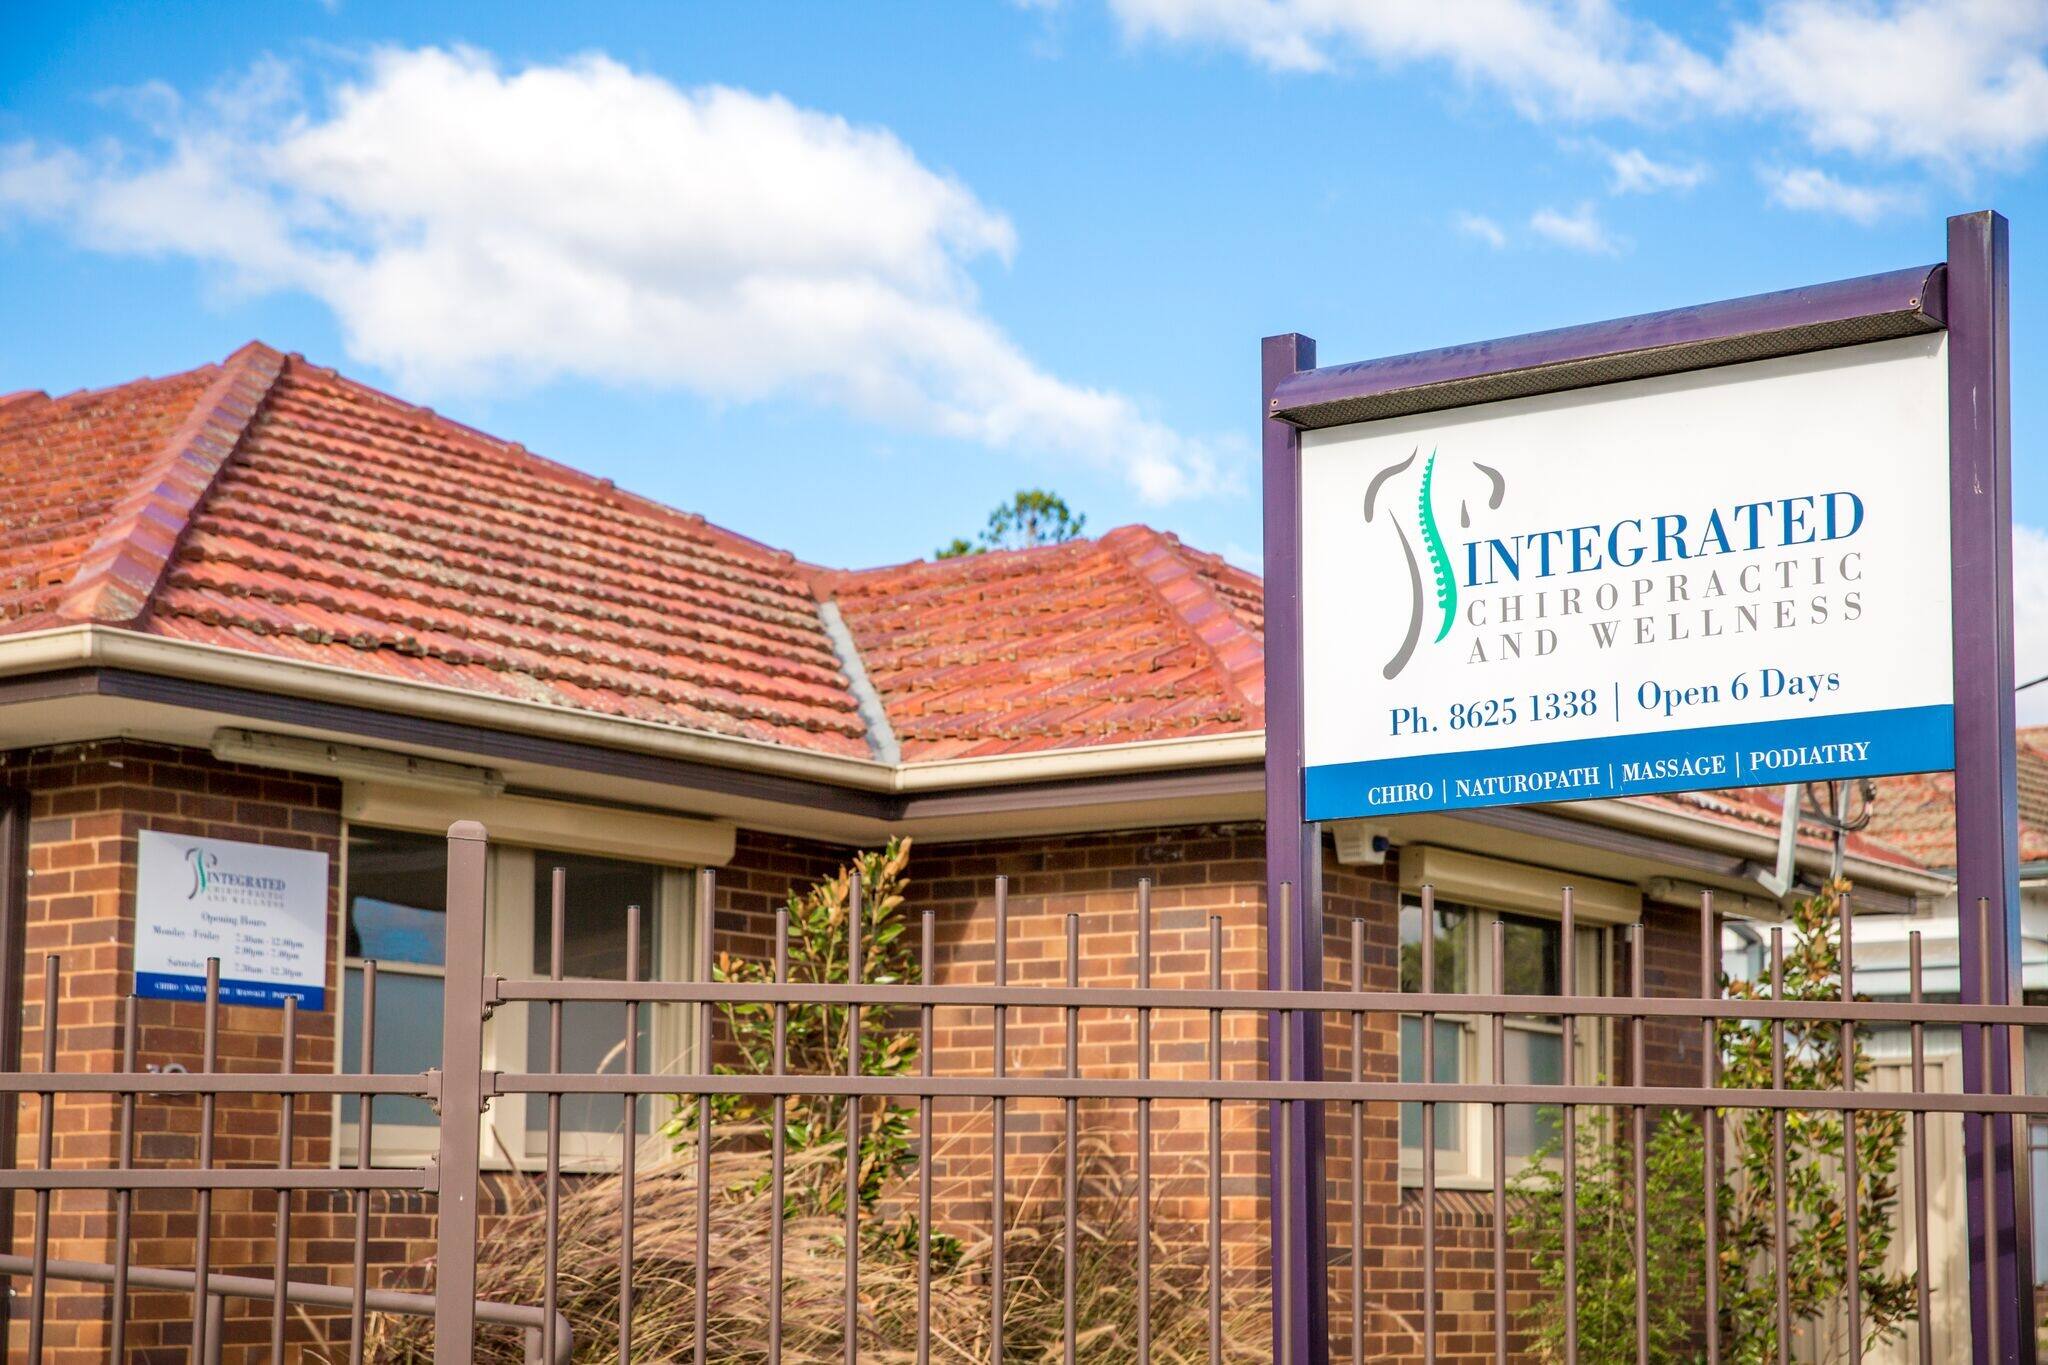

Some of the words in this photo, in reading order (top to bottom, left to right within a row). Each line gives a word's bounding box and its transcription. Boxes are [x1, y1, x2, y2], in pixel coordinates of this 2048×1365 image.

[1463, 492, 1864, 588] INTEGRATED
[1467, 551, 1863, 627] CHIROPRACTIC
[1467, 629, 1560, 665] AND
[1591, 591, 1863, 651] WELLNESS
[1389, 707, 1438, 736] Ph.
[1449, 696, 1518, 731] 8625
[1529, 689, 1598, 722] 1338
[1638, 678, 1721, 717] Open
[1730, 672, 1749, 701] 6
[1760, 668, 1841, 703] Days
[1367, 781, 1434, 806] CHIRO
[1455, 767, 1600, 798] NATUROPATH
[1622, 755, 1726, 783] MASSAGE
[1749, 740, 1871, 771] PODIATRY
[207, 872, 286, 890] INTEGRATED
[153, 926, 185, 938] Monday
[193, 929, 220, 941] Friday
[201, 912, 237, 926] Opening
[239, 915, 267, 926] Hours
